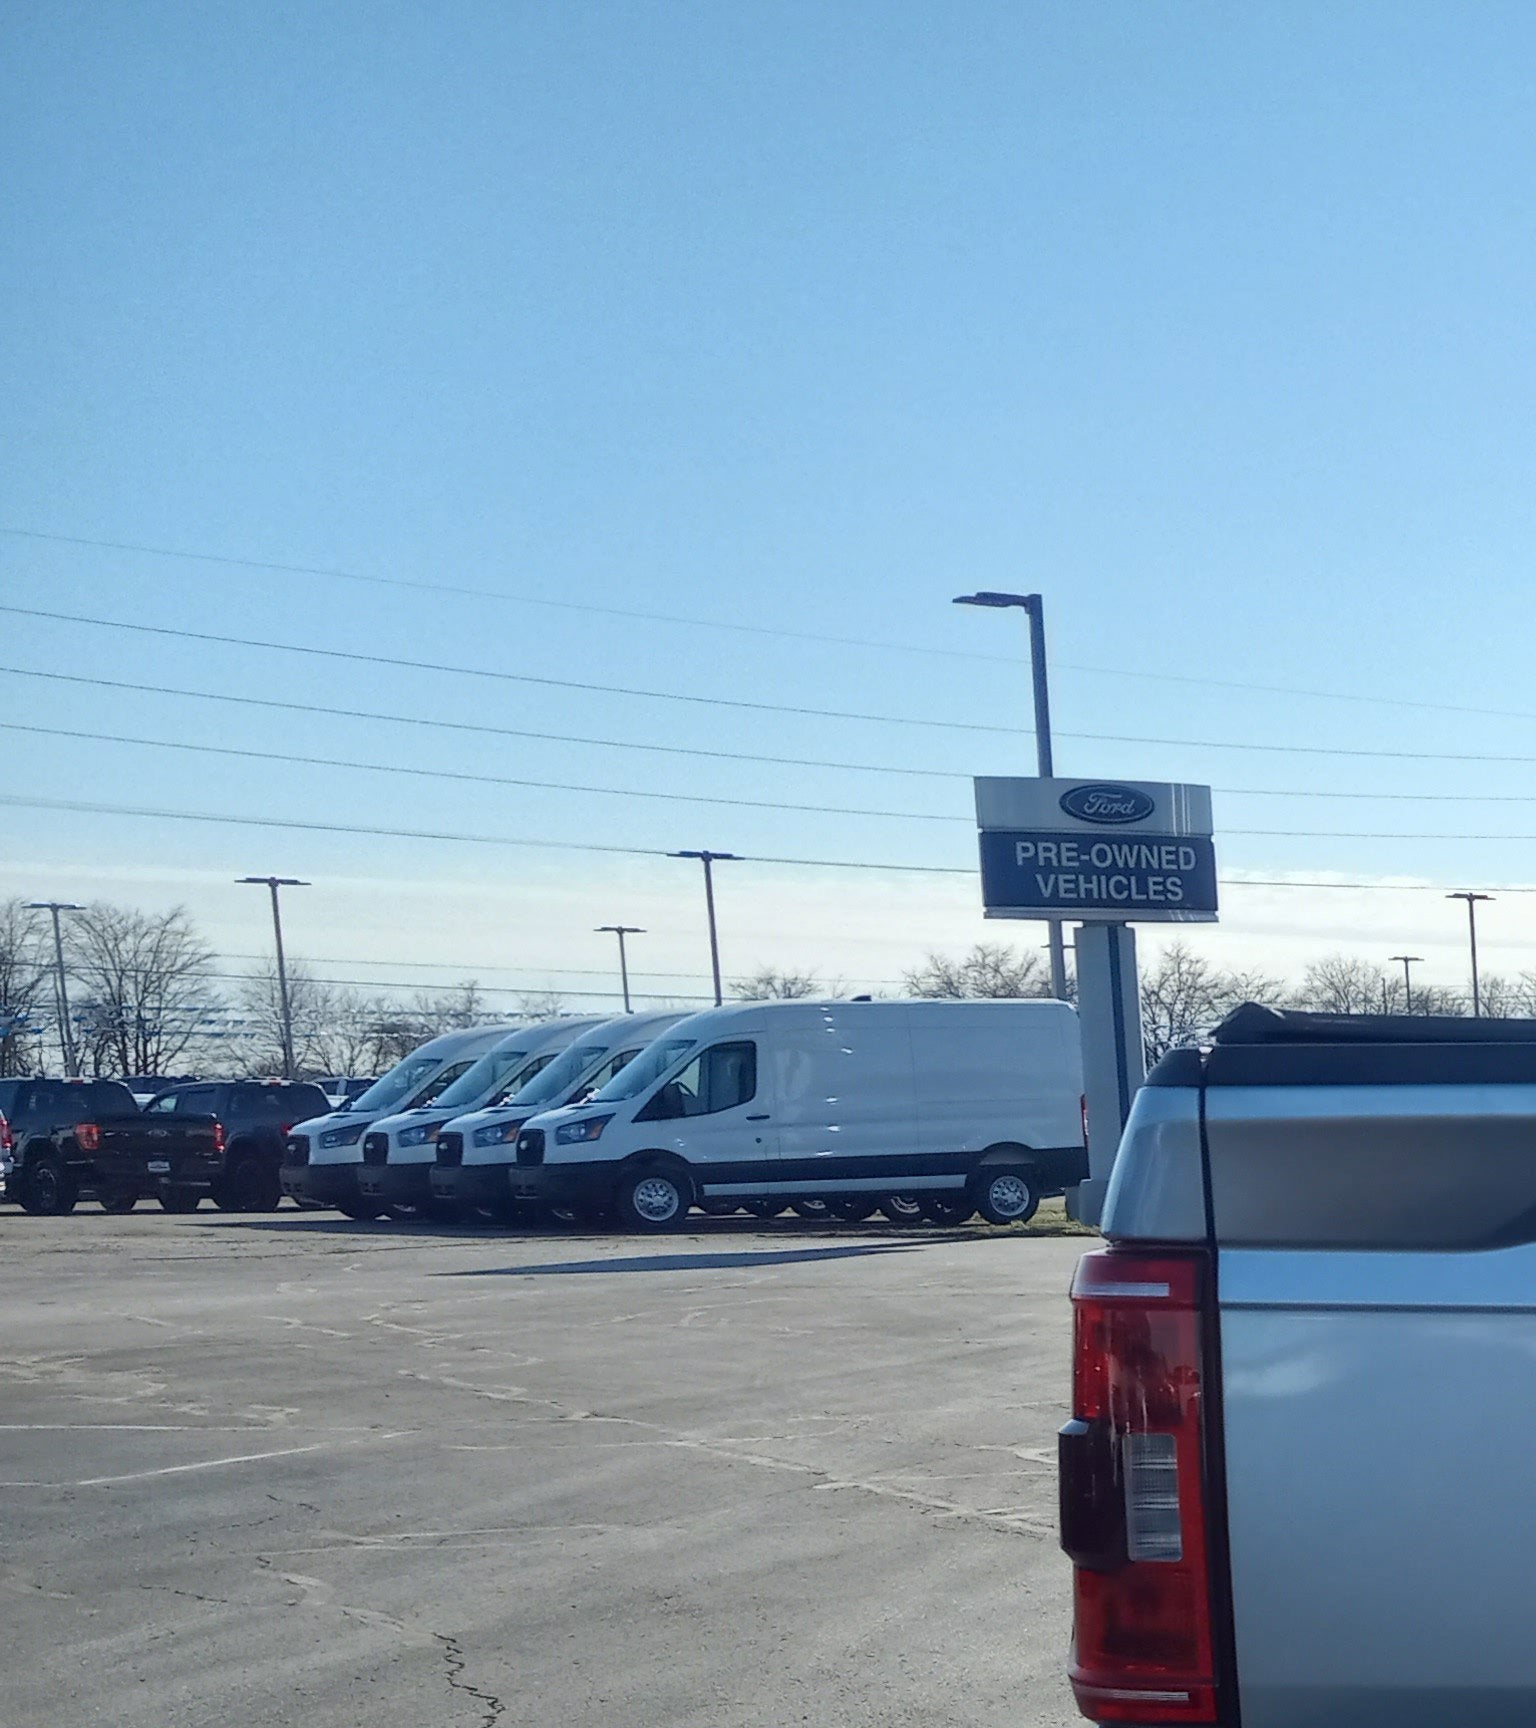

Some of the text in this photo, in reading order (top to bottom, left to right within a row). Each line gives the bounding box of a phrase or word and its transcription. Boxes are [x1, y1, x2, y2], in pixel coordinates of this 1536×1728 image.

[1083, 792, 1135, 815] Ford
[1016, 841, 1197, 871] PRE-OWNED
[1036, 874, 1184, 901] VEHICLES
